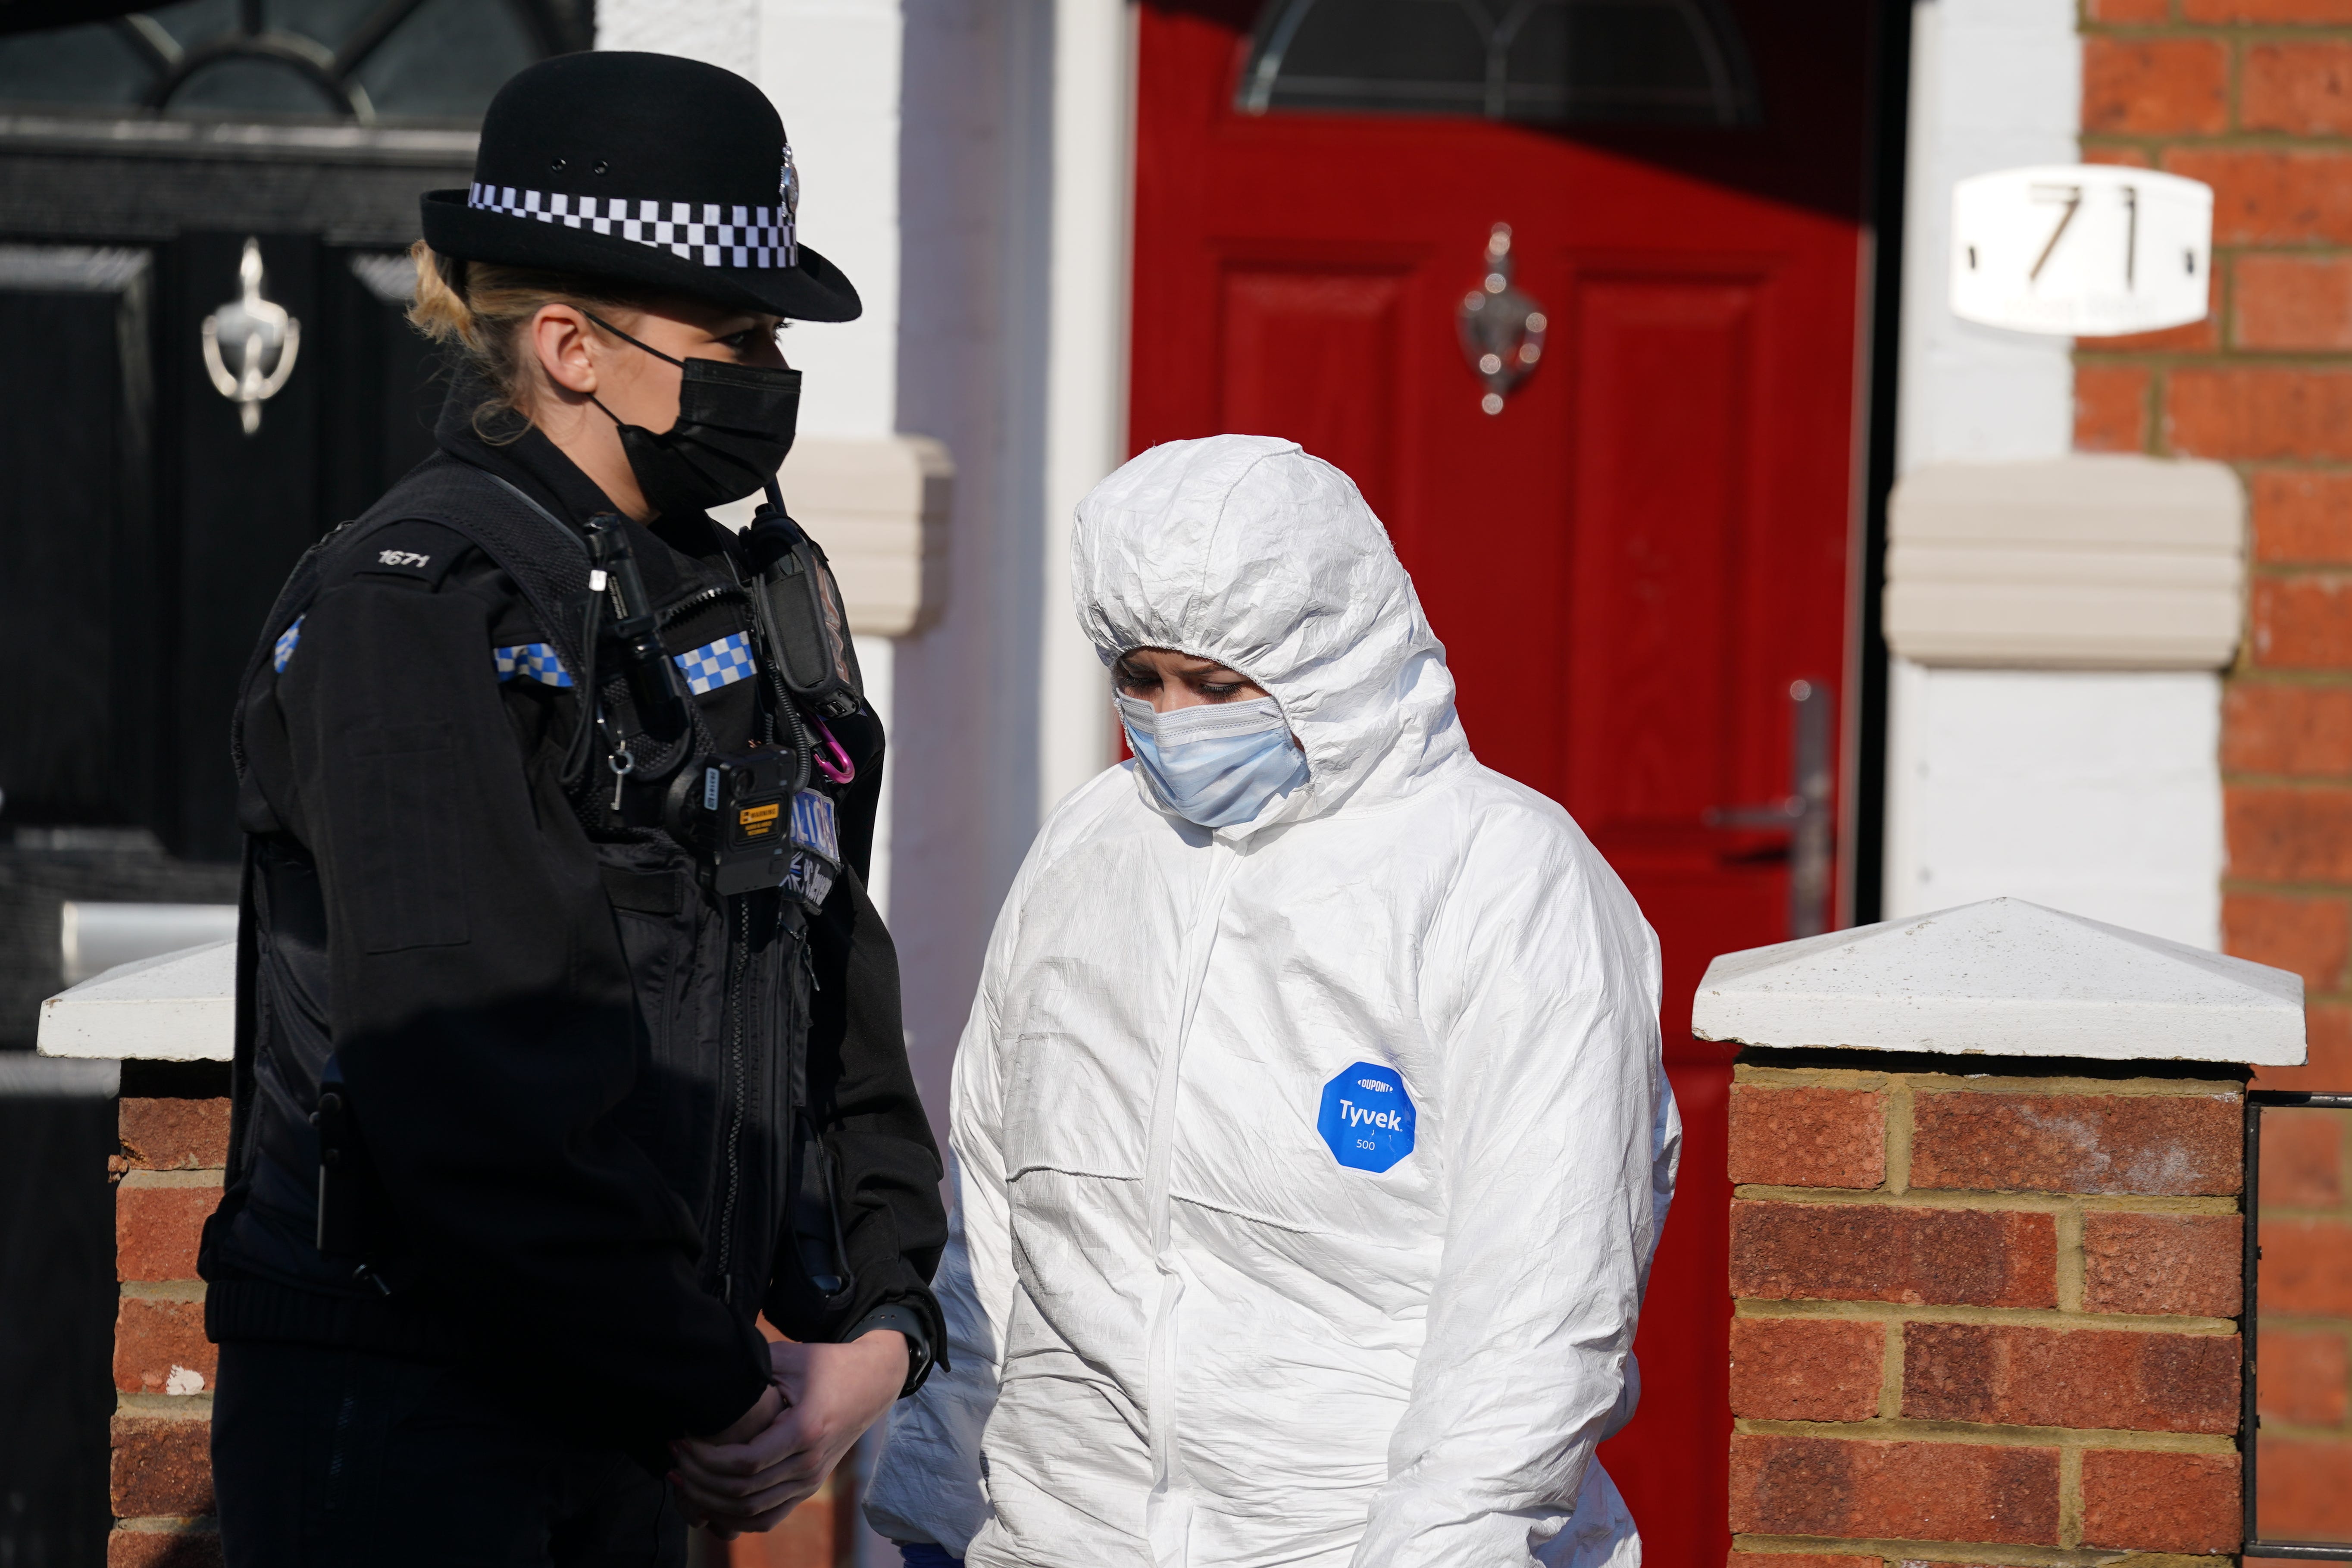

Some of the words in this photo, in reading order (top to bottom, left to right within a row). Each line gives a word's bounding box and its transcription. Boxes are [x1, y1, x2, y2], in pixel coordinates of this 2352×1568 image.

[2028, 182, 2136, 290] 71
[378, 550, 430, 568] 1671
[790, 796, 835, 858] LIC
[1361, 1079, 1390, 1092] DUPONT
[1340, 1099, 1401, 1132] Tyvek
[1356, 1139, 1375, 1151] 500
